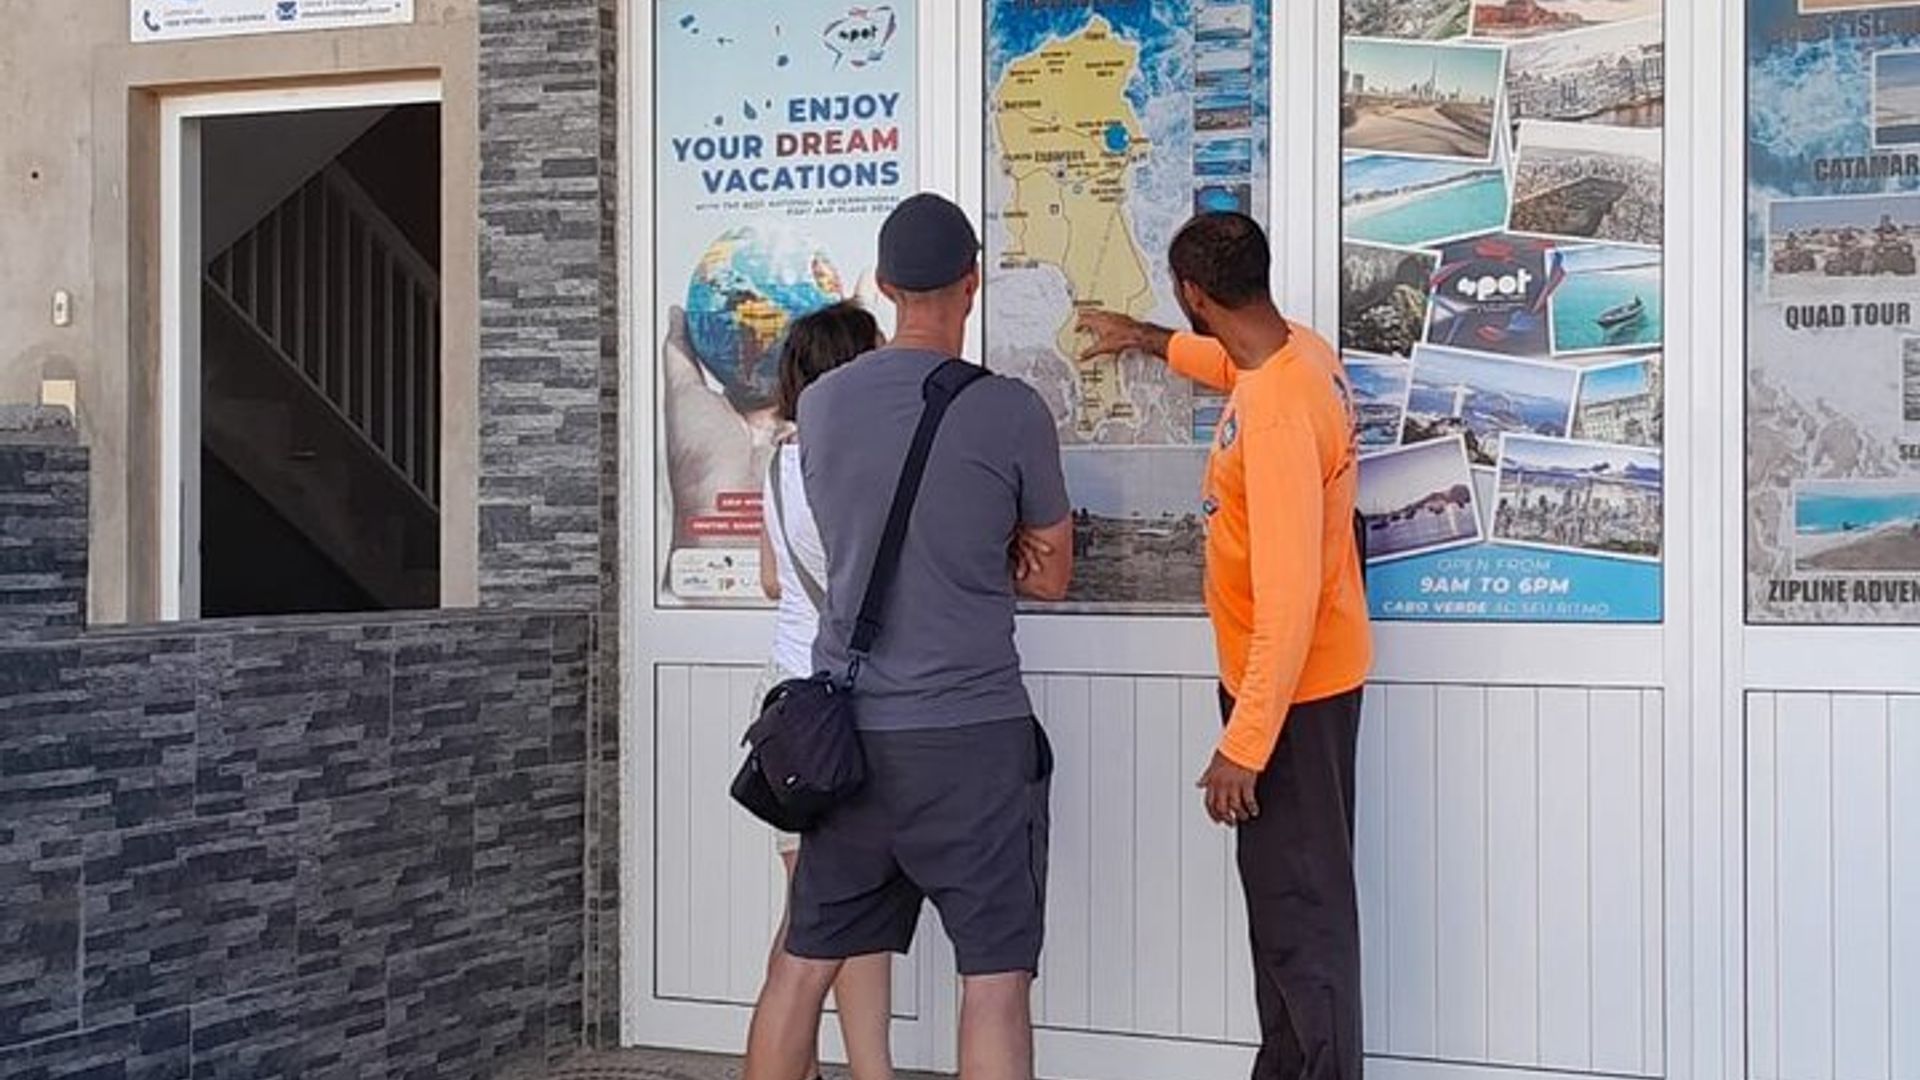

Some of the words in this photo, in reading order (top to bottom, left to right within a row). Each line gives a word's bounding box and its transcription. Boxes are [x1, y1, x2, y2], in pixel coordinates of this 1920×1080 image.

[788, 93, 899, 122] ENJOY
[672, 135, 763, 162] YOUR
[776, 127, 898, 157] DREAM
[702, 161, 899, 194] VACATIONS
[1786, 305, 1845, 330] QUAD
[1853, 303, 1911, 326] TOUR
[1437, 558, 1489, 572] OPEN
[1498, 558, 1551, 572] FROM
[1420, 576, 1469, 593] 9AM
[1476, 576, 1510, 593] TO
[1518, 576, 1570, 594] 6PM
[1768, 580, 1848, 602] ZIPLINE
[1382, 601, 1428, 613] CABO
[1434, 601, 1486, 613] VERDE
